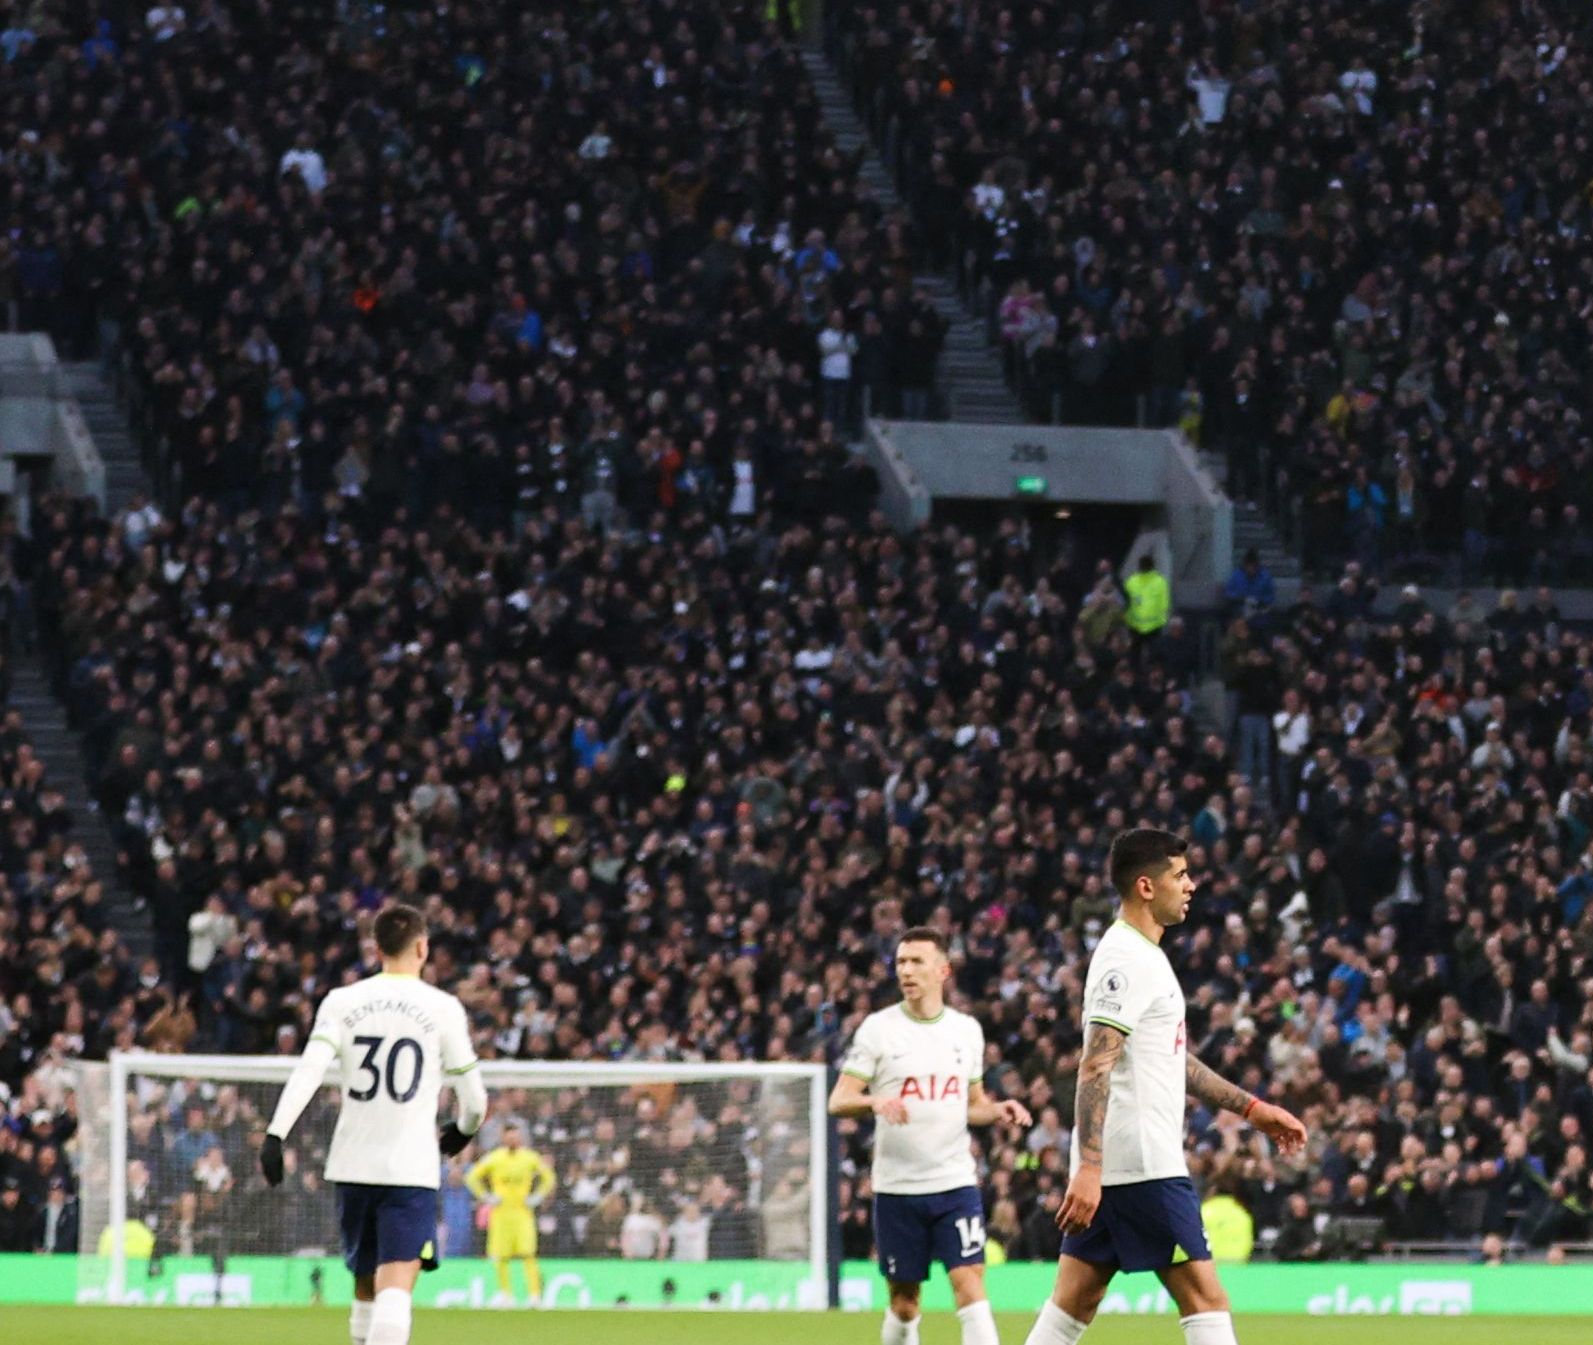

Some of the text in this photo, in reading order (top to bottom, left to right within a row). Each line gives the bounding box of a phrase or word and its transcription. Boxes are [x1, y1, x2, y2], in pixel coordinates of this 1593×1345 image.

[348, 1035, 424, 1103] 30
[900, 1074, 961, 1101] AIA
[955, 1216, 986, 1249] 14
